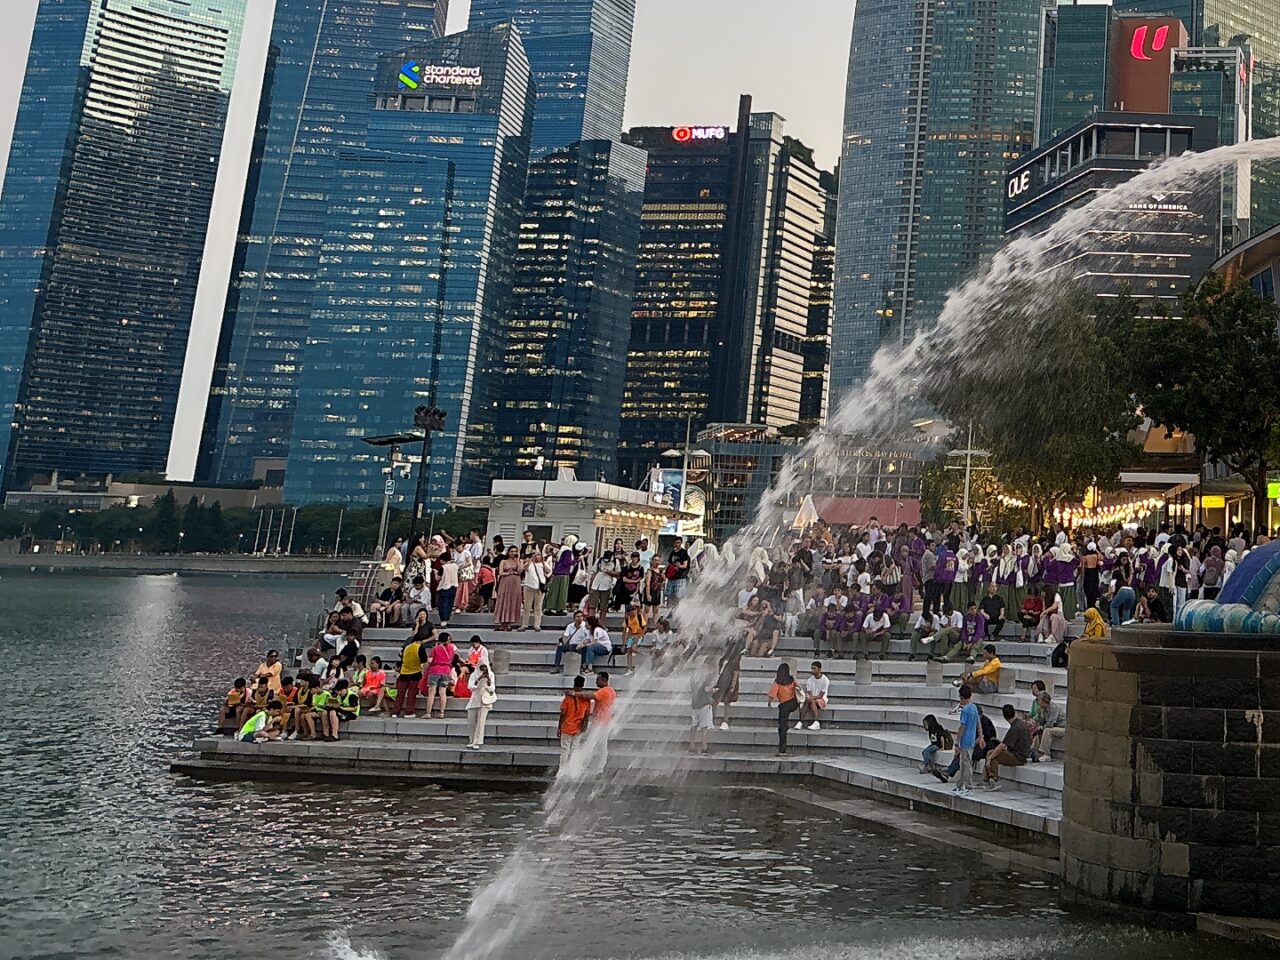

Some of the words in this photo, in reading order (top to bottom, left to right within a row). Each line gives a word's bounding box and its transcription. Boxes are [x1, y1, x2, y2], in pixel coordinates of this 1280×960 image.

[424, 65, 480, 76] standard
[423, 74, 482, 86] chartered
[692, 128, 724, 139] MUFG
[1009, 171, 1030, 198] OUE
